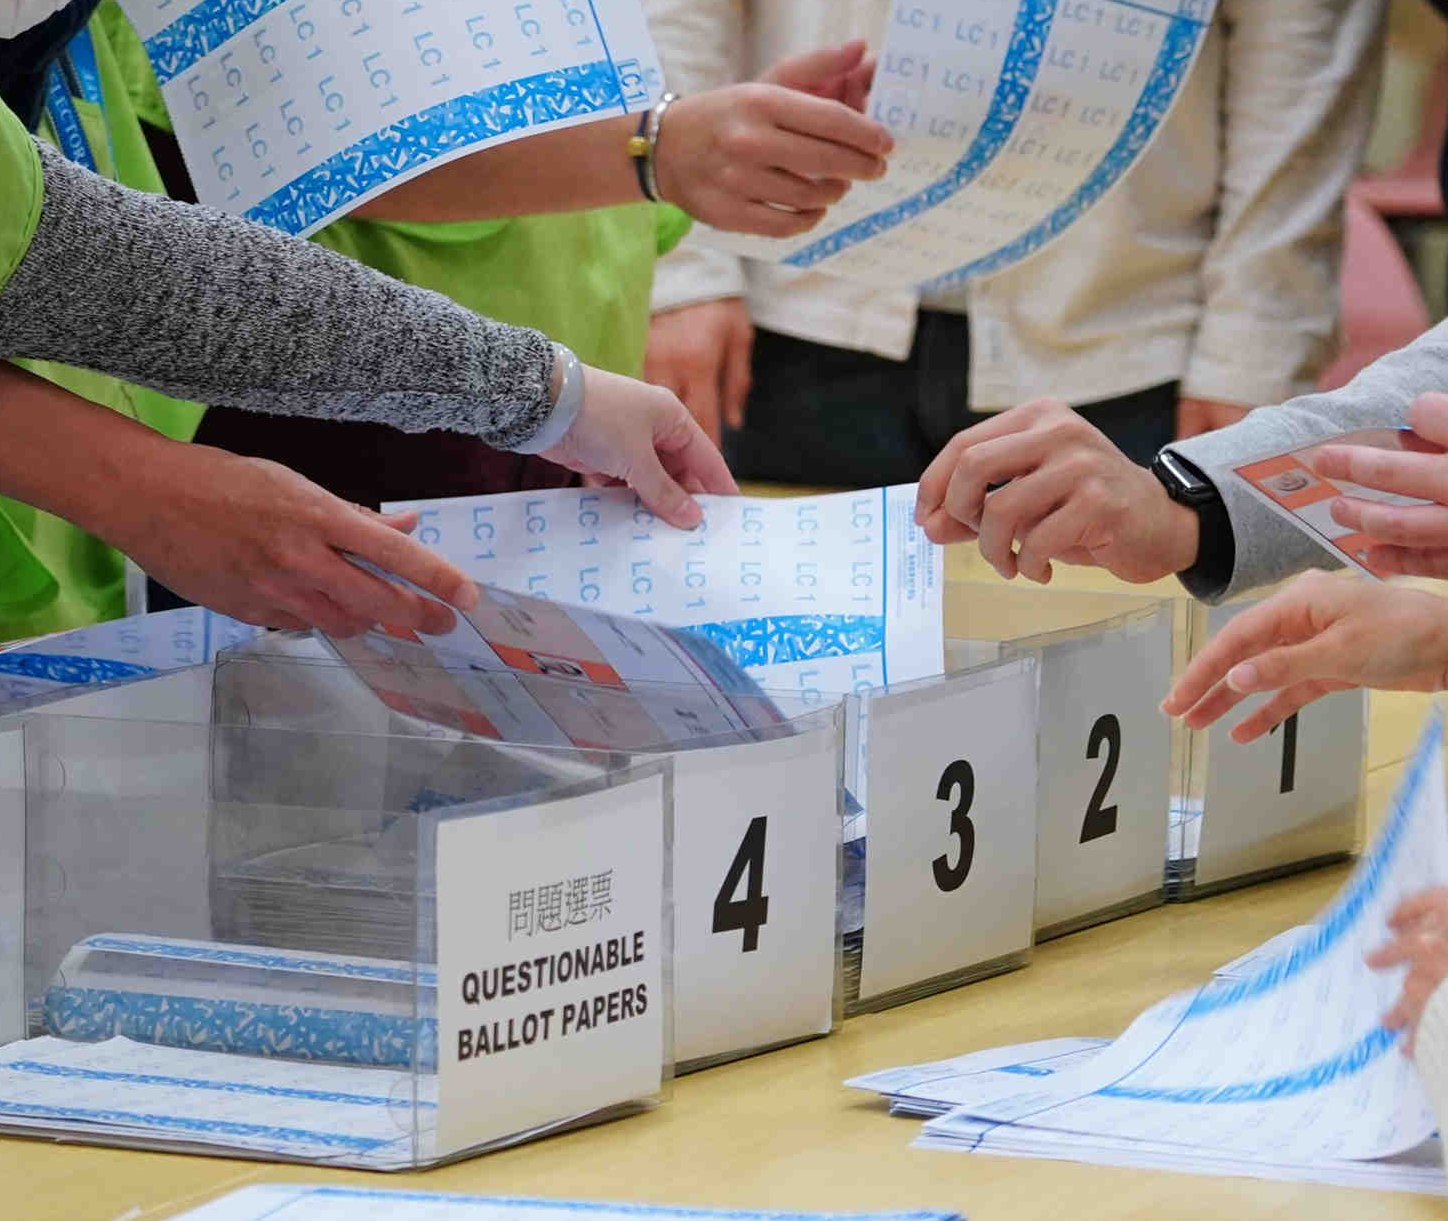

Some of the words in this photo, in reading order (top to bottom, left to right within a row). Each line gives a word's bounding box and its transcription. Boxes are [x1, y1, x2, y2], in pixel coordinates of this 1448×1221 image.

[1079, 713, 1121, 844] 2
[1270, 708, 1298, 793] 1
[932, 759, 975, 892] 3
[507, 868, 613, 941] 問題選票
[712, 816, 768, 952] 4
[462, 931, 644, 1005] QUESTIONABLE
[458, 1009, 555, 1061] BALLOT
[562, 983, 647, 1036] PAPERS
